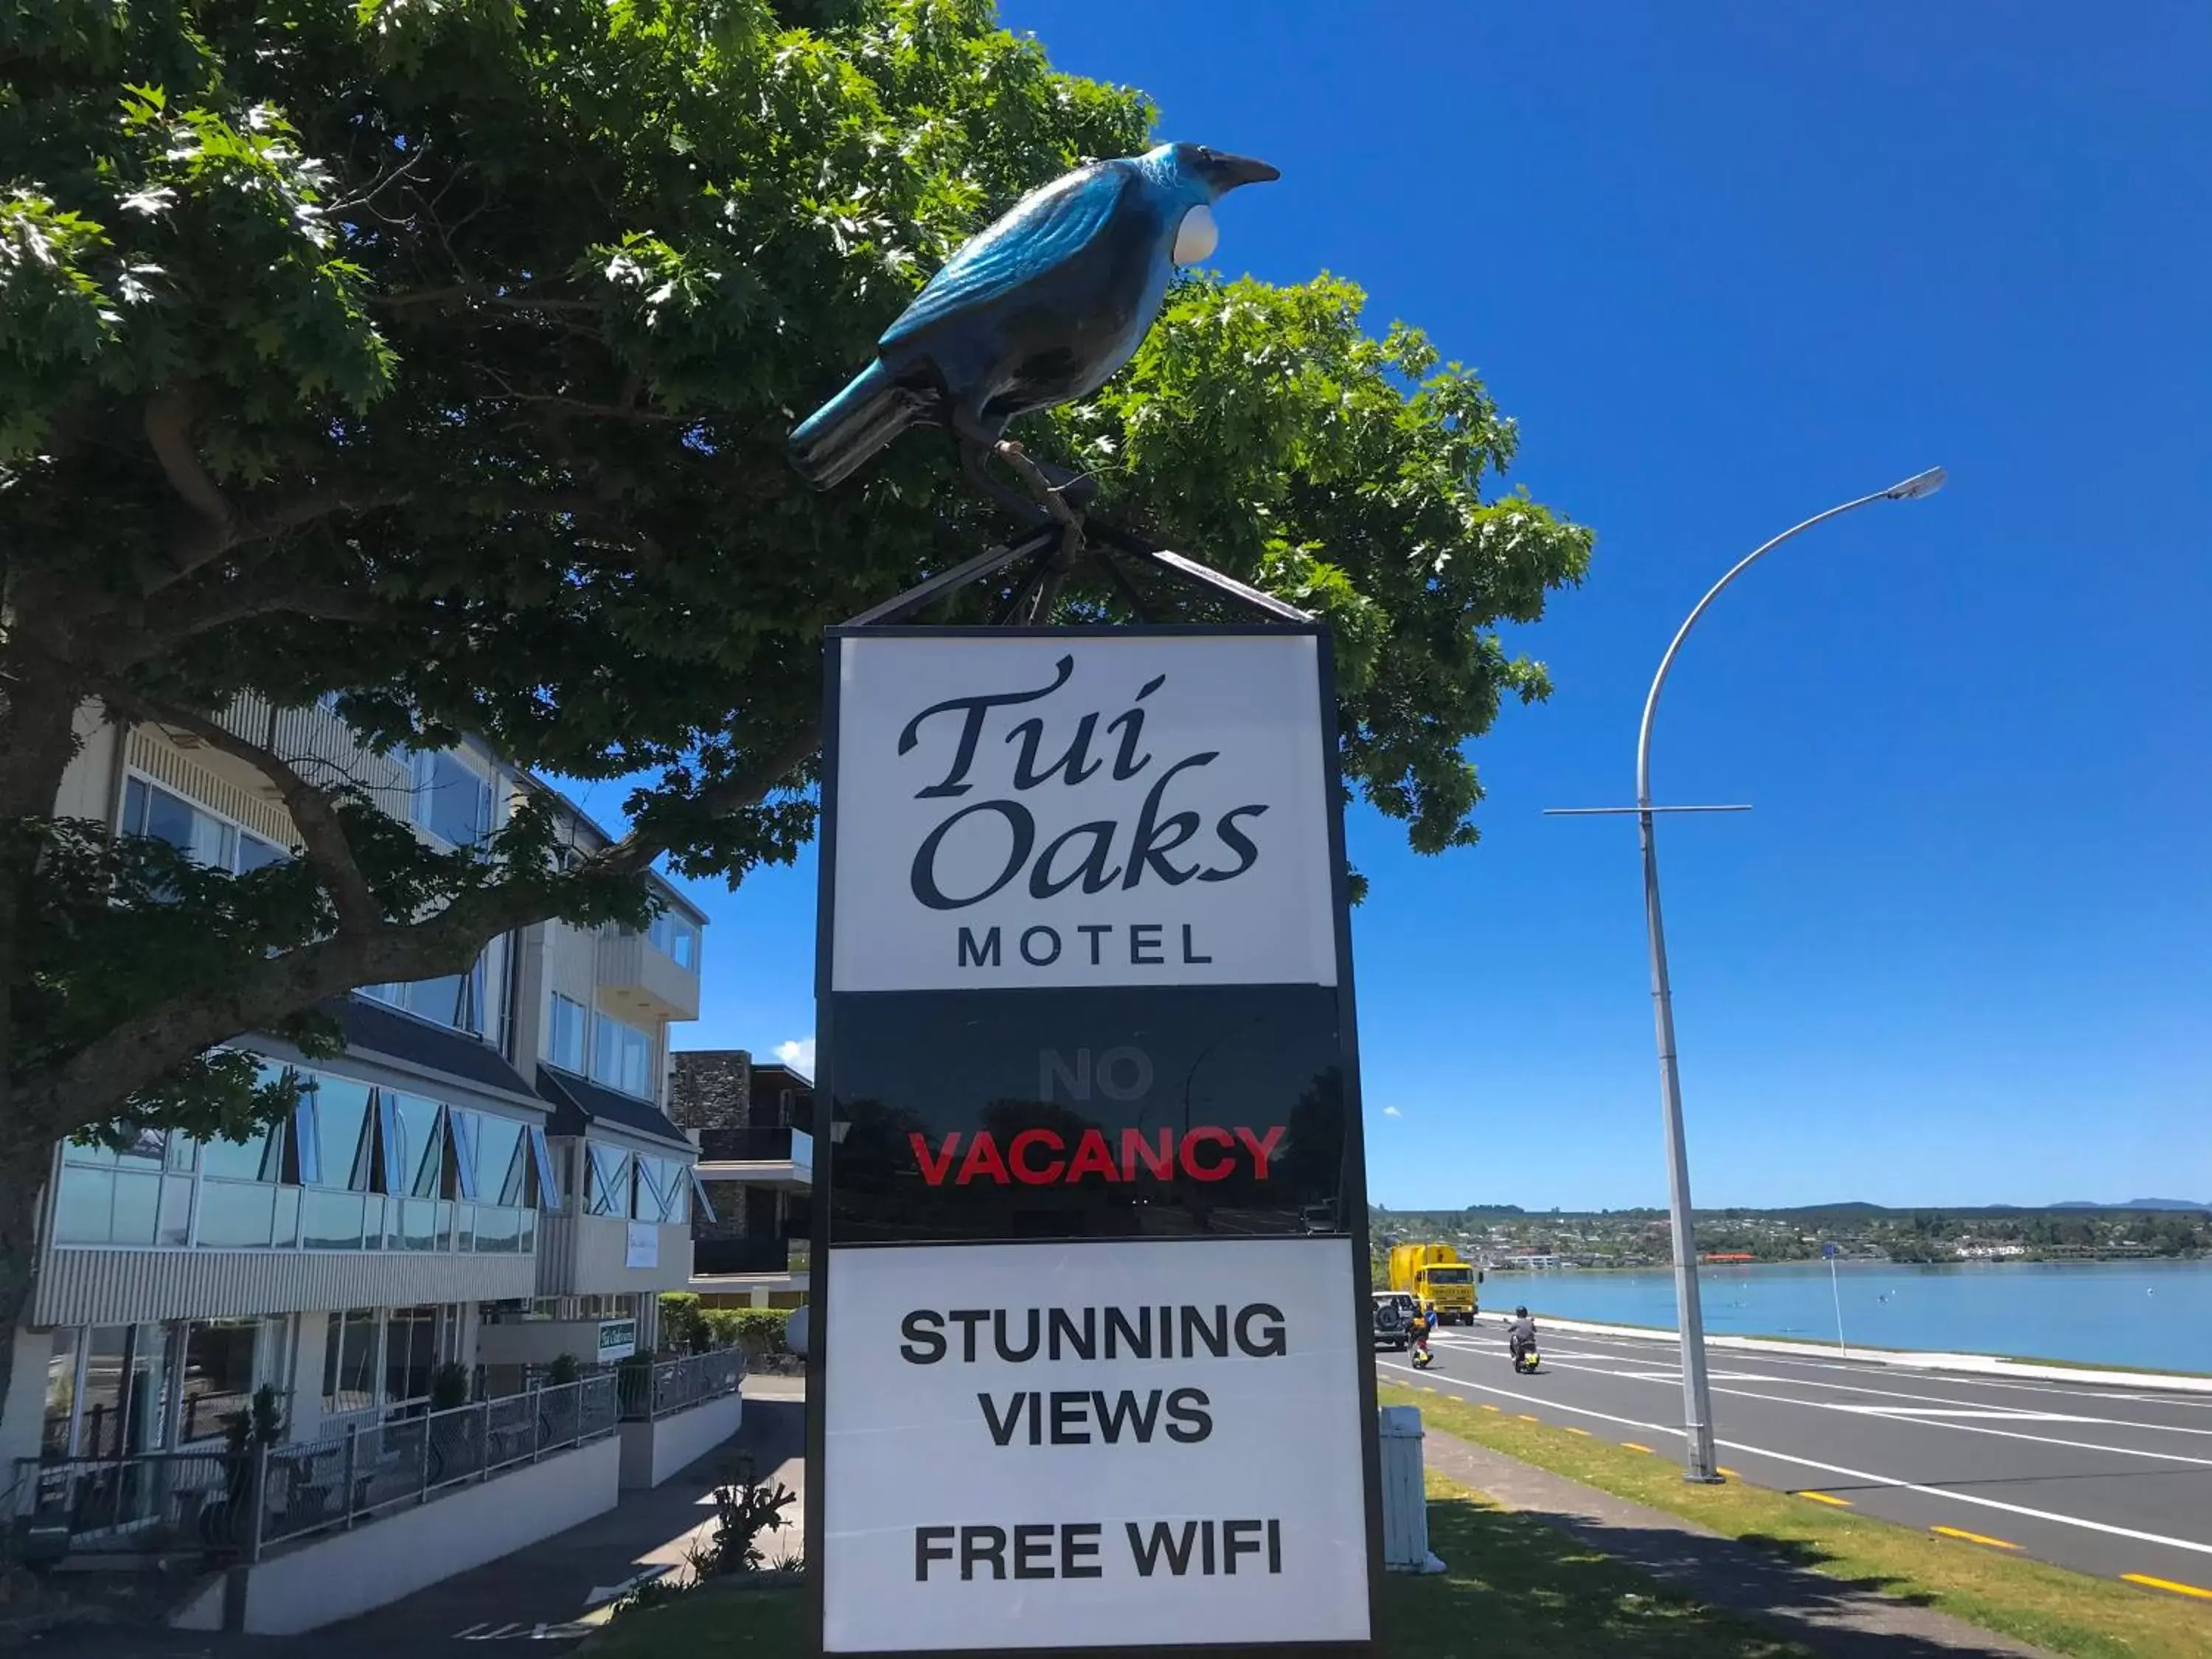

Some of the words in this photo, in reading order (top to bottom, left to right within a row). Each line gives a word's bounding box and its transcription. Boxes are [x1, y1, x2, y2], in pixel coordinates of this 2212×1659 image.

[898, 653, 1166, 799] Tui
[911, 751, 1270, 911] Oaks
[958, 923, 1213, 968] MOTEL
[1039, 1047, 1154, 1102] NO
[909, 1127, 1286, 1186] VACANCY
[900, 1303, 1287, 1364] STUNNING
[977, 1388, 1213, 1446] VIEWS
[915, 1523, 1102, 1582] FREE
[1125, 1519, 1281, 1576] WIFI
